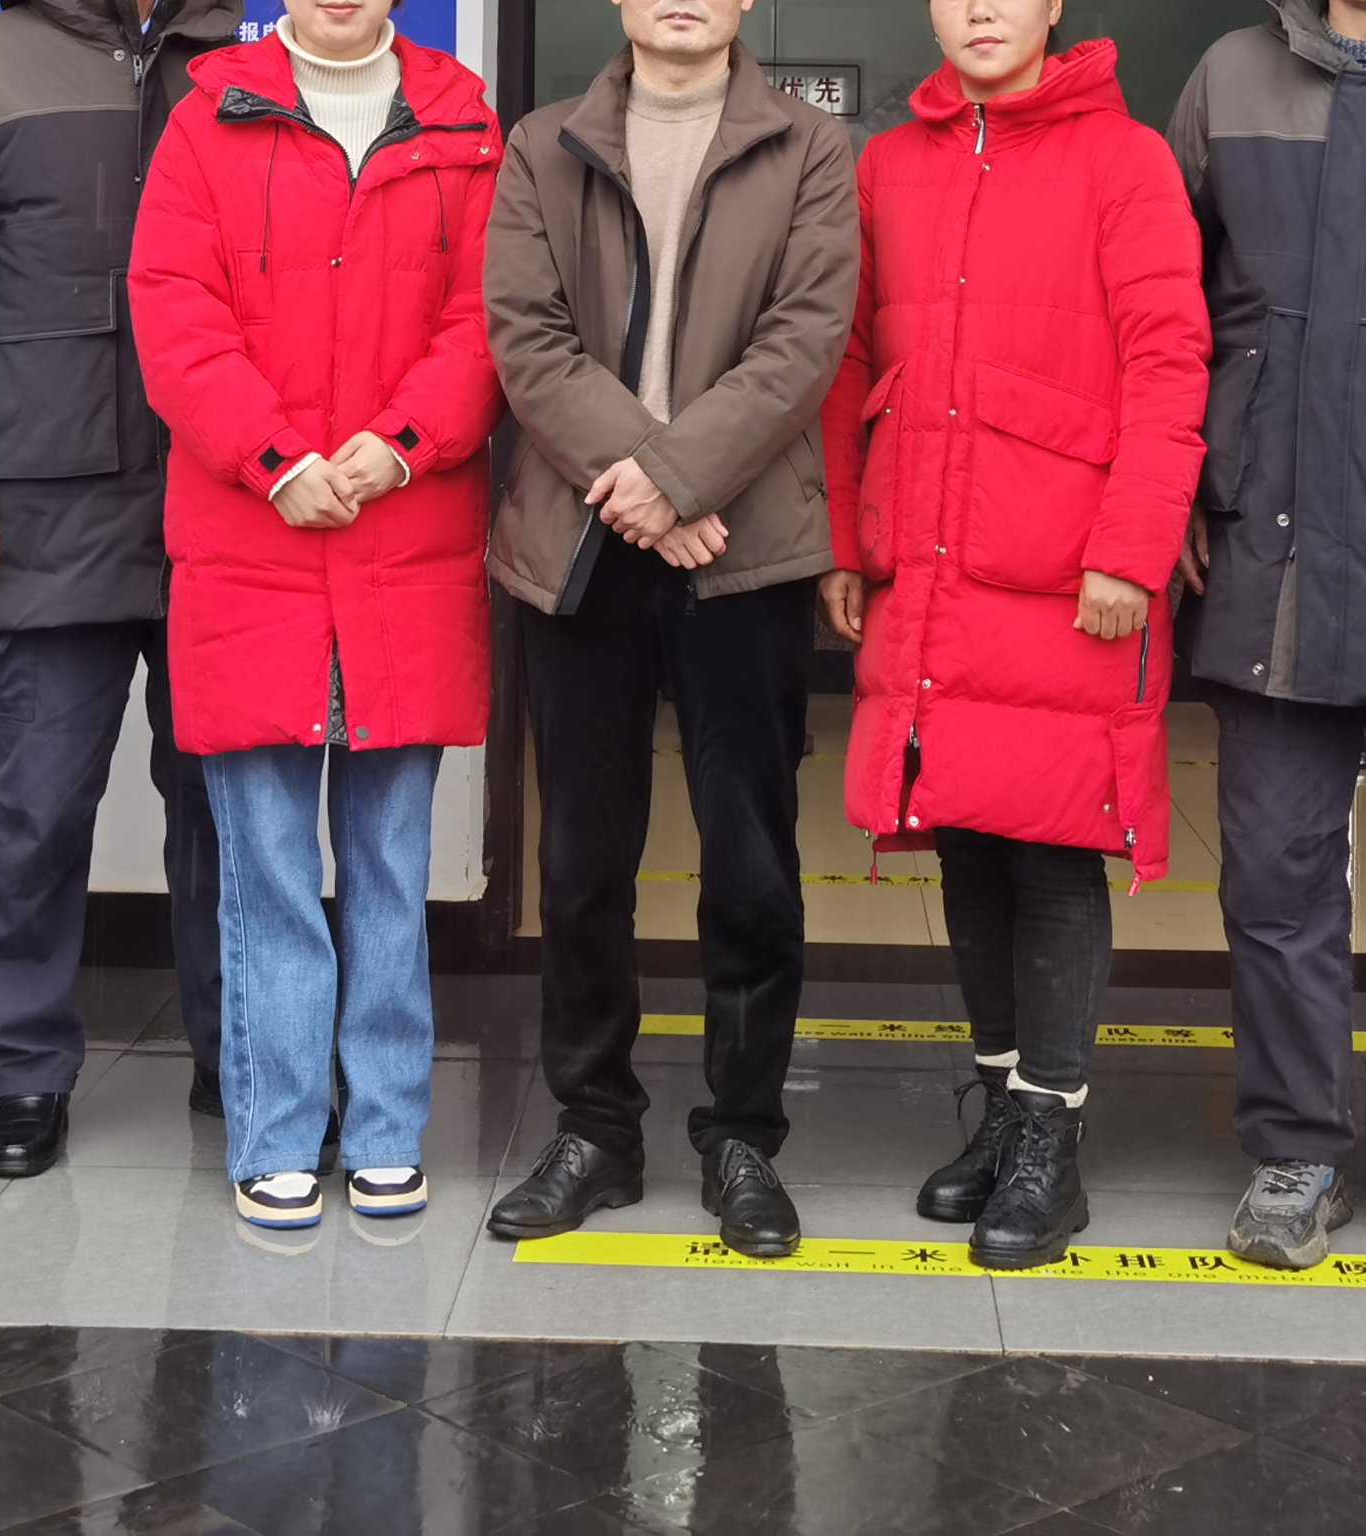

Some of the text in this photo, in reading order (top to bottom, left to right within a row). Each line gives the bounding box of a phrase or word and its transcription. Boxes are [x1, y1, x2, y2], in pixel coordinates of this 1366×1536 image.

[685, 1256, 776, 1266] Please
[797, 1260, 851, 1270] wait
[872, 1262, 894, 1271] in
[914, 1263, 963, 1273] line
[1106, 1268, 1146, 1278] the
[1168, 1271, 1217, 1279] one
